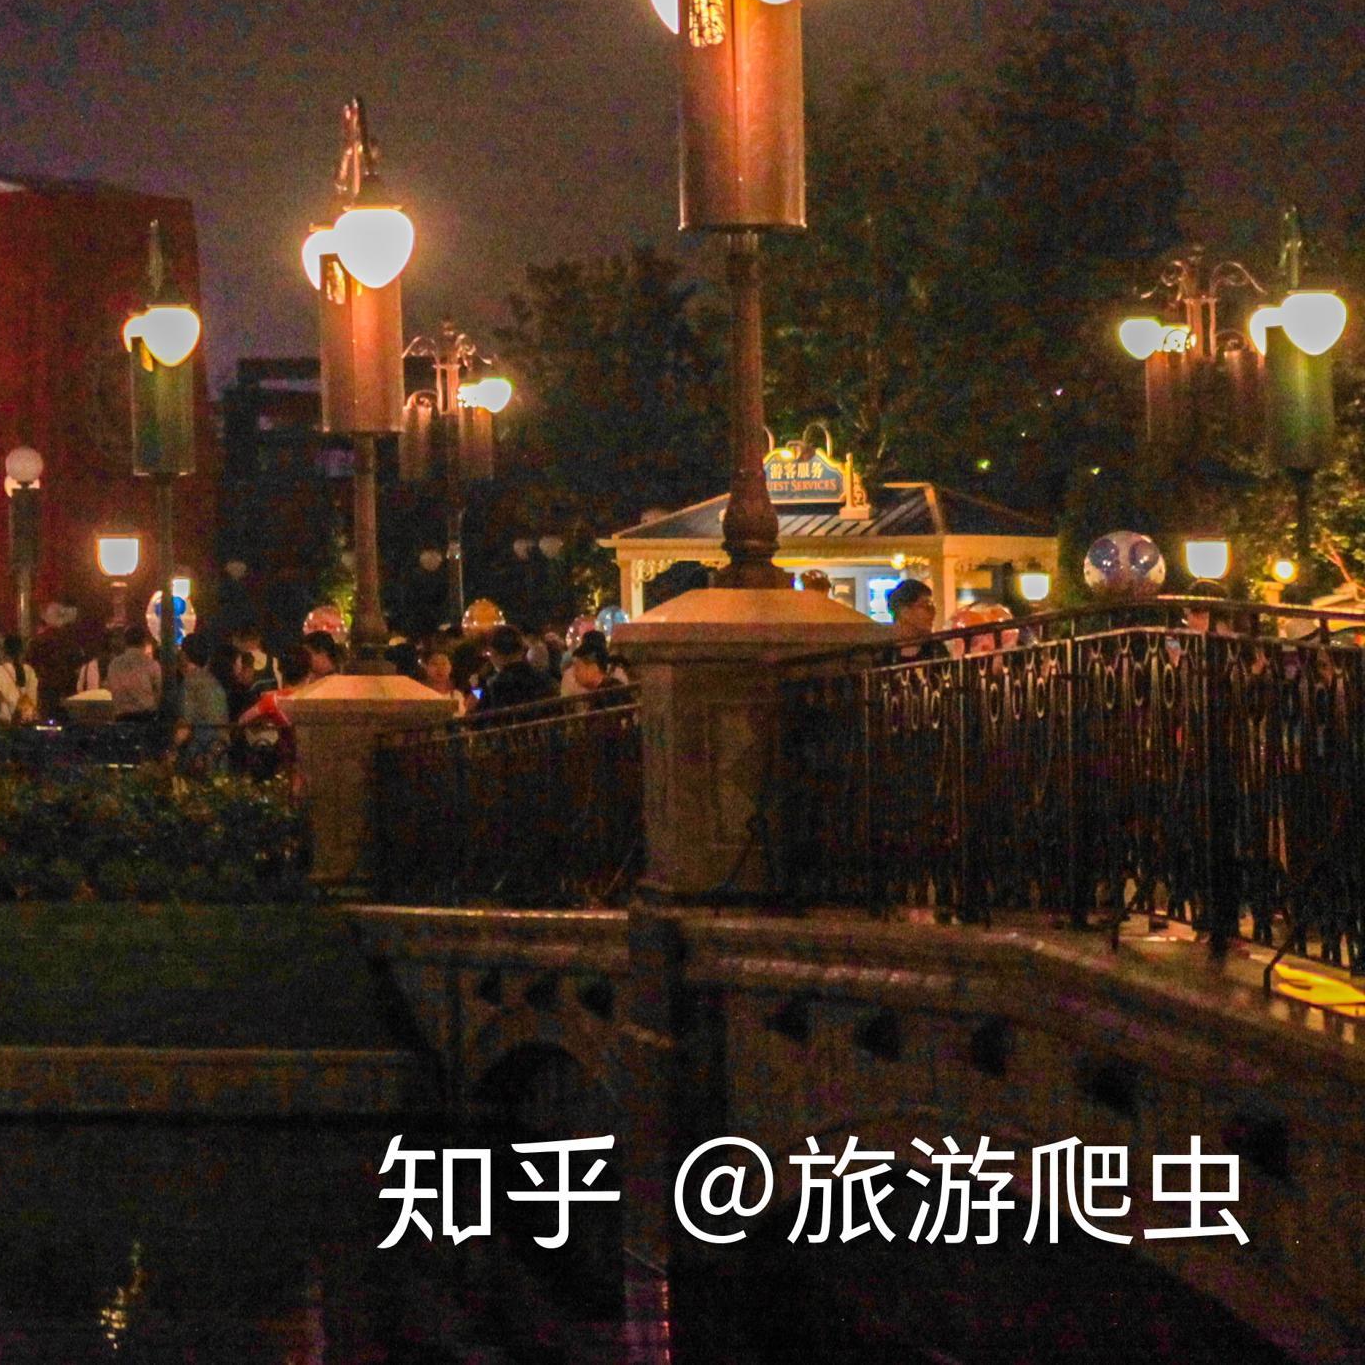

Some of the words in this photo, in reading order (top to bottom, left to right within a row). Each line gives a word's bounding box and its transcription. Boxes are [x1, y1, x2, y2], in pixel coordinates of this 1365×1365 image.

[770, 461, 823, 479] 游客服务
[766, 480, 789, 492] UEST
[791, 478, 837, 491] SERVICES
